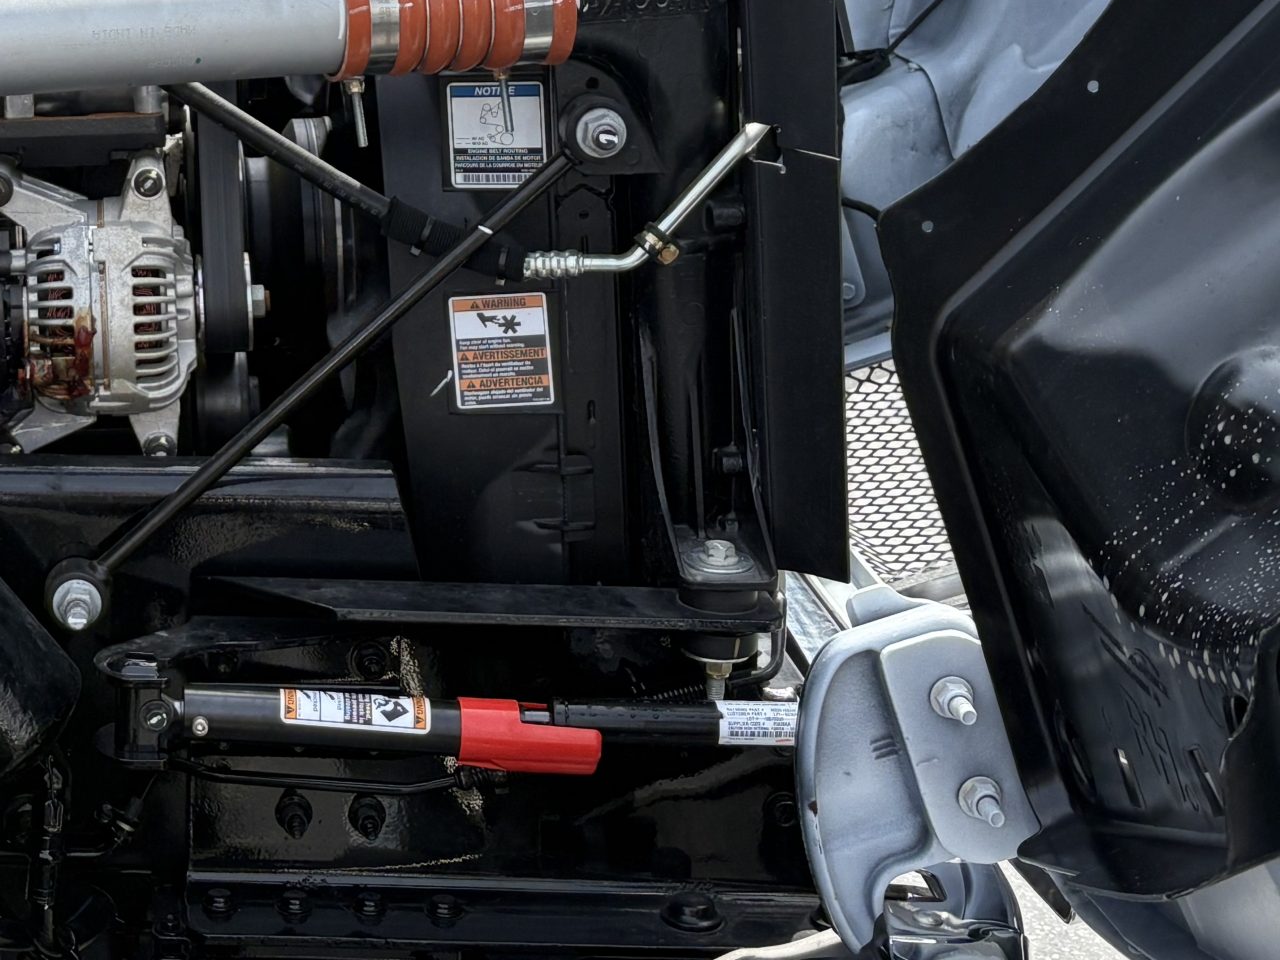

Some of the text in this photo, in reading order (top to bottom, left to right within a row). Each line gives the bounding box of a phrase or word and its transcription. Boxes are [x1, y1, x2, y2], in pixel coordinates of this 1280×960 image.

[474, 87, 515, 95] NOTIE
[482, 298, 526, 308] WARNING
[473, 349, 544, 360] AVERTISSEMENT
[480, 377, 543, 387] ADVERTENCIA
